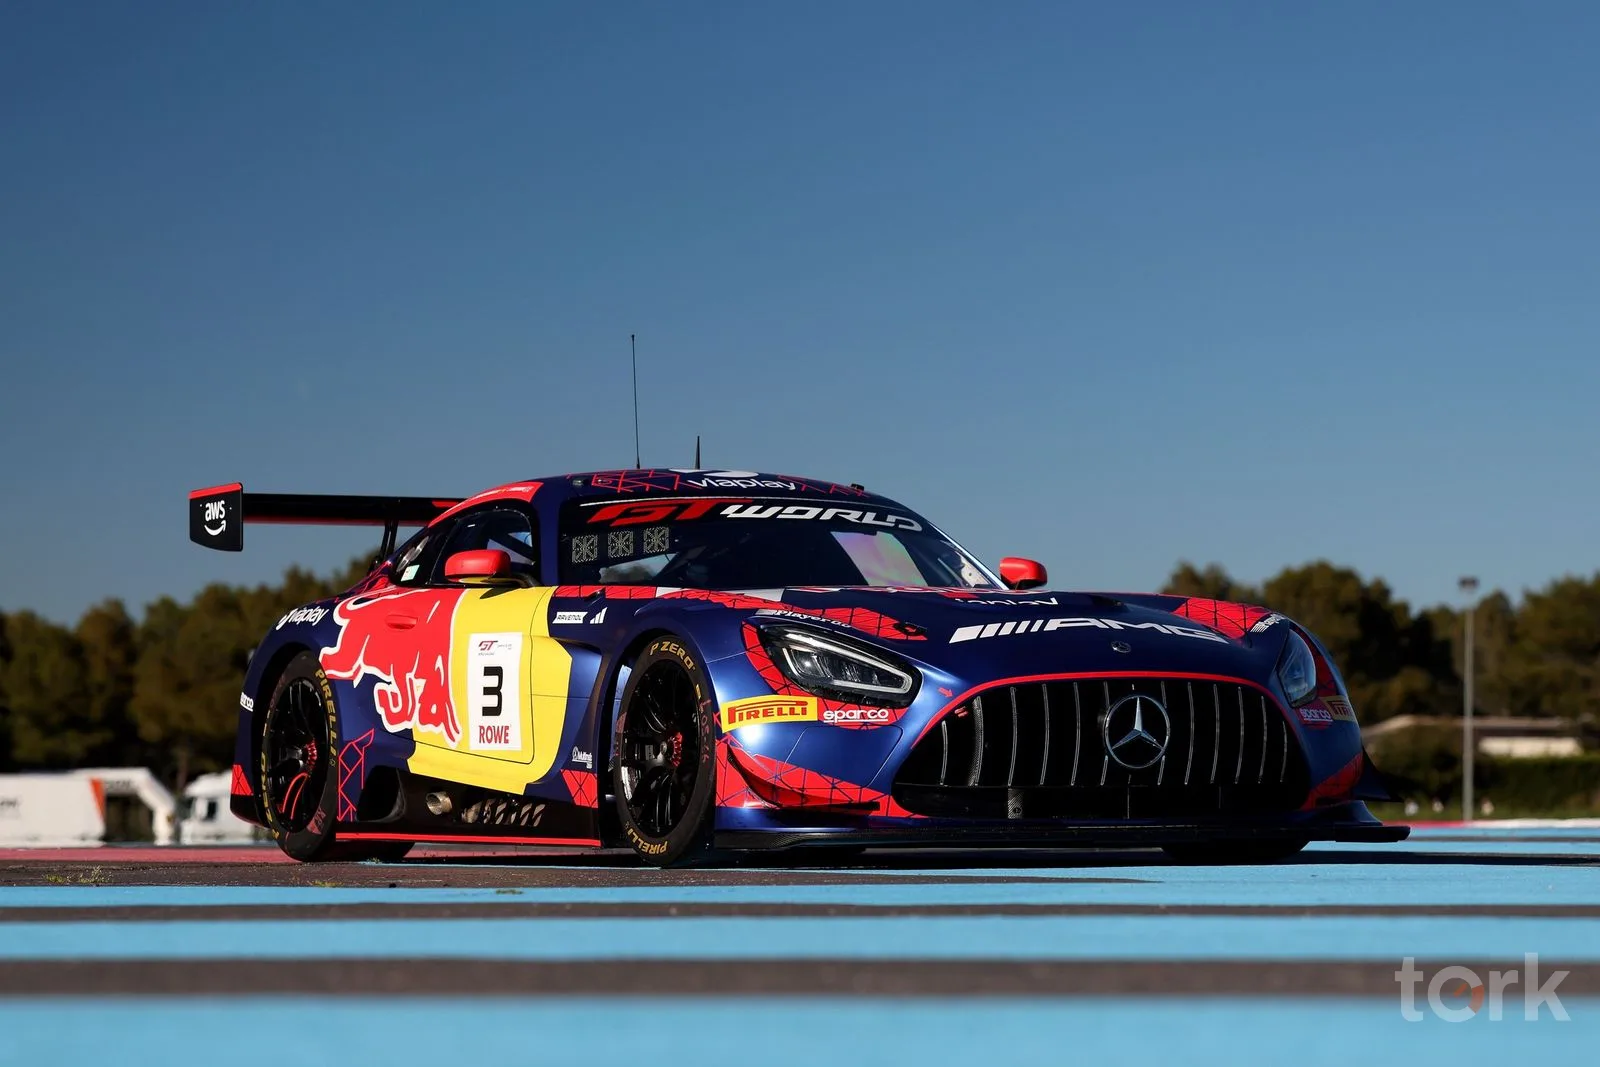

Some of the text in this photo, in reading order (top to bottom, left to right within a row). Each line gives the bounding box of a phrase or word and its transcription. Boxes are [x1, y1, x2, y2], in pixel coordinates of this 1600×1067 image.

[205, 500, 226, 521] aws
[720, 504, 922, 532] WORLD
[1043, 618, 1229, 644] AMG
[660, 641, 693, 670] ZERO
[482, 666, 503, 716] 3
[315, 668, 337, 757] PIRELLI
[728, 700, 808, 724] PIRELLI
[823, 708, 888, 723] sparco
[479, 725, 509, 744] ROWE
[626, 828, 668, 855] PIRELLI
